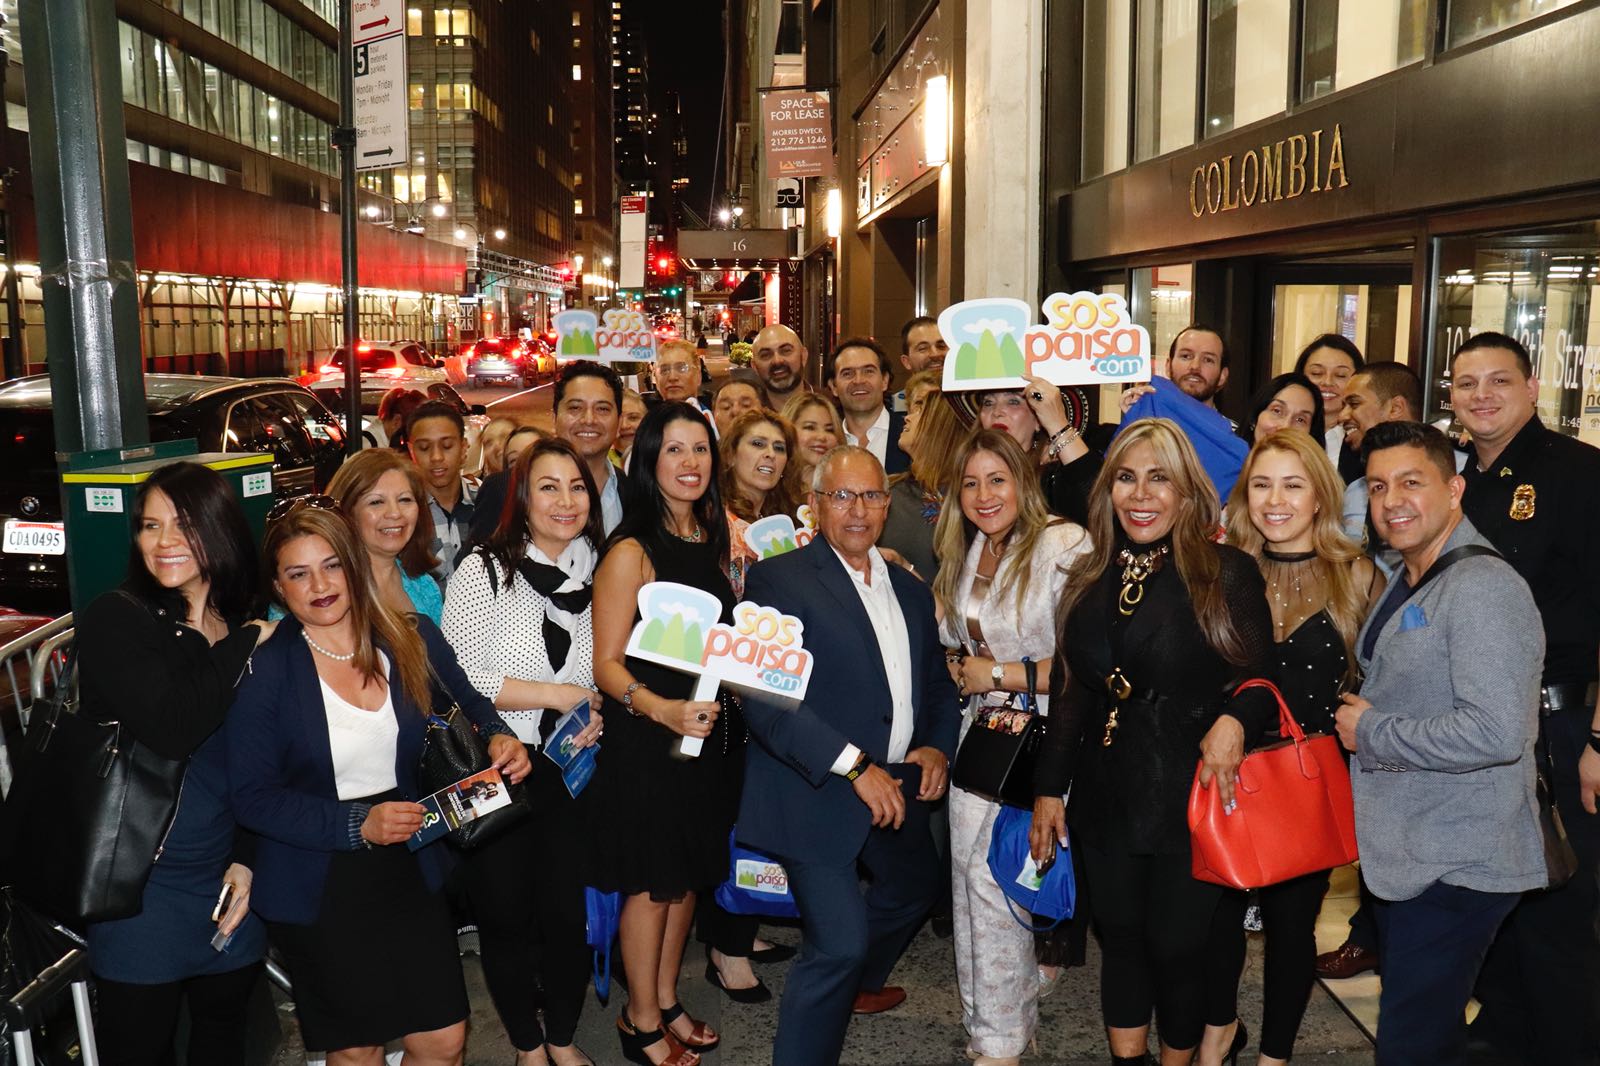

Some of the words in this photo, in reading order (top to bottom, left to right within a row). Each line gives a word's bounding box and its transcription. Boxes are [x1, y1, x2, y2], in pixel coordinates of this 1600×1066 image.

[357, 47, 366, 74] 5
[370, 54, 388, 63] metered
[370, 65, 386, 74] parking
[356, 85, 373, 94] Monday
[378, 80, 393, 90] Friday
[356, 98, 366, 108] 7pm
[370, 93, 390, 104] Midnight
[780, 98, 813, 109] SPACE
[357, 114, 377, 126] Saturday
[771, 111, 792, 120] FOR
[794, 109, 824, 120] LEASE
[371, 123, 391, 136] Midnight
[1190, 123, 1350, 218] COLOMBIA
[733, 238, 746, 252] 16
[1052, 297, 1120, 330] SOS
[608, 313, 641, 331] SOS
[596, 331, 651, 356] paisa
[1025, 329, 1140, 378] paisa
[1090, 359, 1142, 374] .com
[249, 479, 265, 490] DOT
[93, 495, 114, 506] DOT
[10, 531, 30, 546] CDA
[32, 532, 60, 546] 0495
[736, 608, 796, 646] SOS
[700, 628, 808, 676] paisa
[757, 670, 800, 689] .com
[764, 865, 782, 876] SOS
[756, 874, 786, 887] paisa
